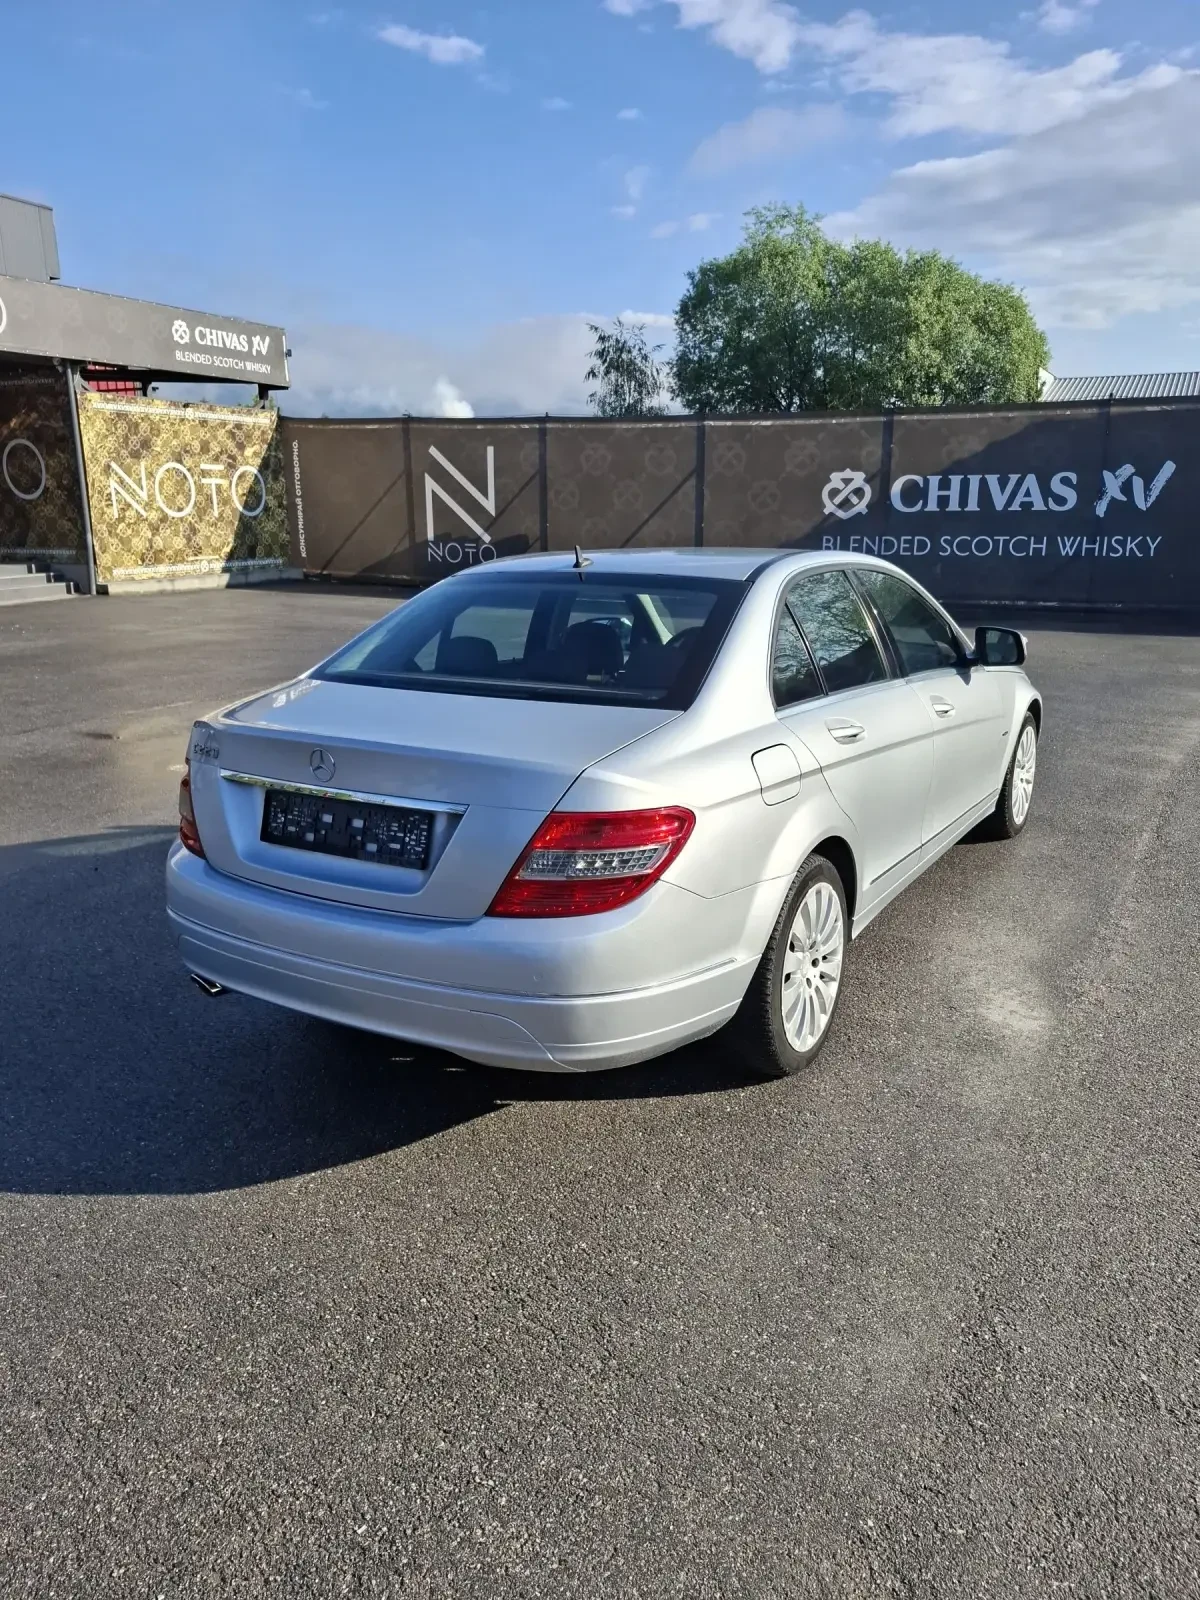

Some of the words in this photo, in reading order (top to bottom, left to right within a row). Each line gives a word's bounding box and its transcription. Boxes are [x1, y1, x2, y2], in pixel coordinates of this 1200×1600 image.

[175, 350, 212, 365] BLENDED
[213, 356, 245, 370] SCOTCH
[245, 361, 271, 374] WHISKY
[194, 326, 249, 352] CHIVAS
[251, 335, 270, 356] XV
[108, 460, 266, 518] NOTO
[292, 439, 302, 496] ОТГОВОРНО.
[890, 471, 1078, 512] CHIVAS
[1094, 460, 1177, 517] XV
[295, 497, 307, 557] КОНСУМИРАЙ
[822, 535, 931, 557] BLENDED
[939, 535, 1047, 557] SCOTCH
[1057, 535, 1162, 557] WHISKY
[427, 542, 497, 564] NOTO
